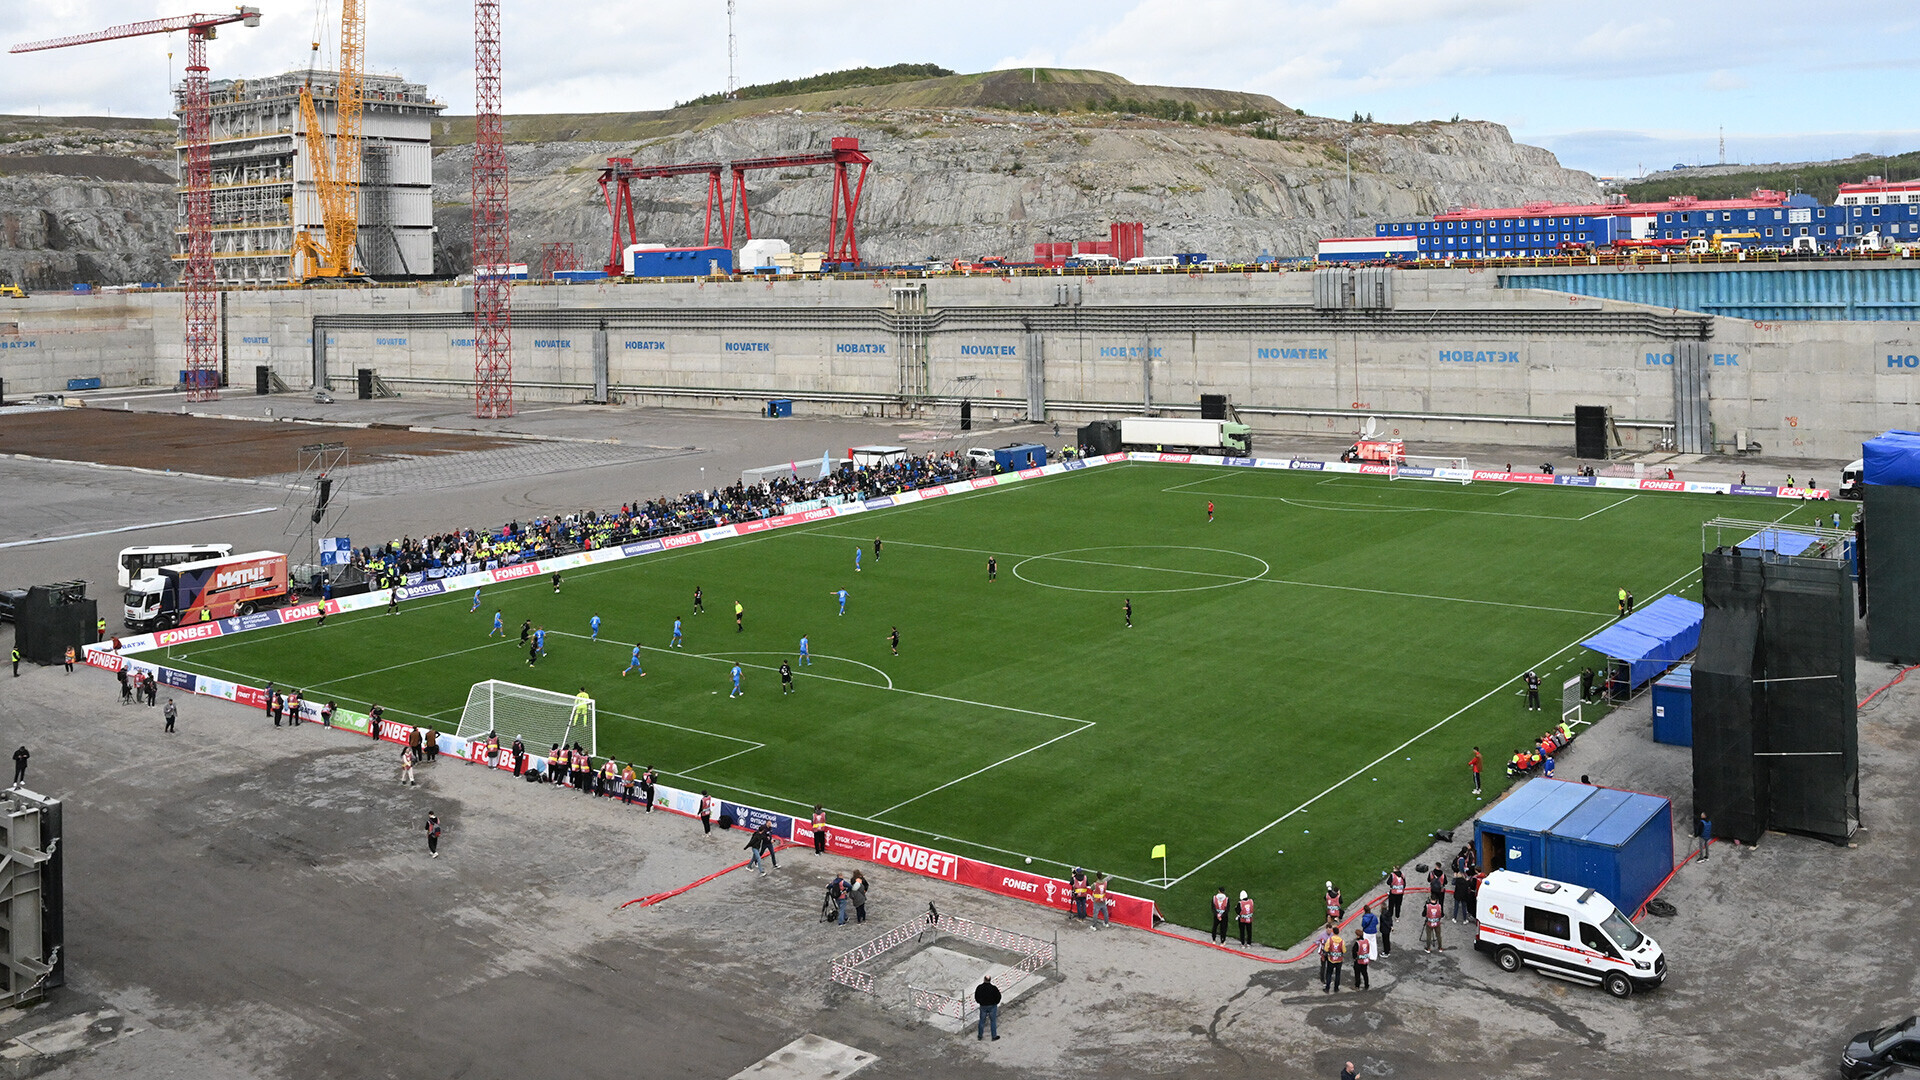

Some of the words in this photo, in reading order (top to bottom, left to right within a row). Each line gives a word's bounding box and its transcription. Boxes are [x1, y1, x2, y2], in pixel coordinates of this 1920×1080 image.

[0, 341, 36, 349] ВАТЭК
[376, 338, 407, 346] NOVATEK
[534, 340, 571, 348] NOVATEK
[625, 341, 665, 350] НОВАТЭК
[725, 342, 769, 352] NOVATEK
[836, 344, 886, 354] НОВАТЭК
[961, 345, 1016, 355] NOVATEK
[1257, 348, 1329, 360] NOVATEK
[1438, 350, 1519, 363] НОВАТЭК
[1646, 353, 1739, 366] NOEK
[1160, 455, 1190, 463] FONBET
[1020, 468, 1042, 480] FONBET
[1474, 471, 1511, 480] FONBET
[972, 477, 996, 488] FONBET
[1642, 481, 1682, 490] FONBET
[921, 486, 946, 499] FONBET
[804, 508, 832, 522] FONBET
[665, 534, 697, 547] FONBET
[495, 564, 535, 580] FONBET
[408, 582, 441, 595] ВОСТОК
[160, 624, 214, 644] FONBET
[87, 651, 122, 670] FONBET
[750, 810, 777, 822] РОССИЙСКИЙ
[835, 835, 850, 844] КУБОК
[851, 838, 871, 848] РОССИИ
[876, 841, 955, 876] FONBET
[1003, 878, 1038, 893] FONBET
